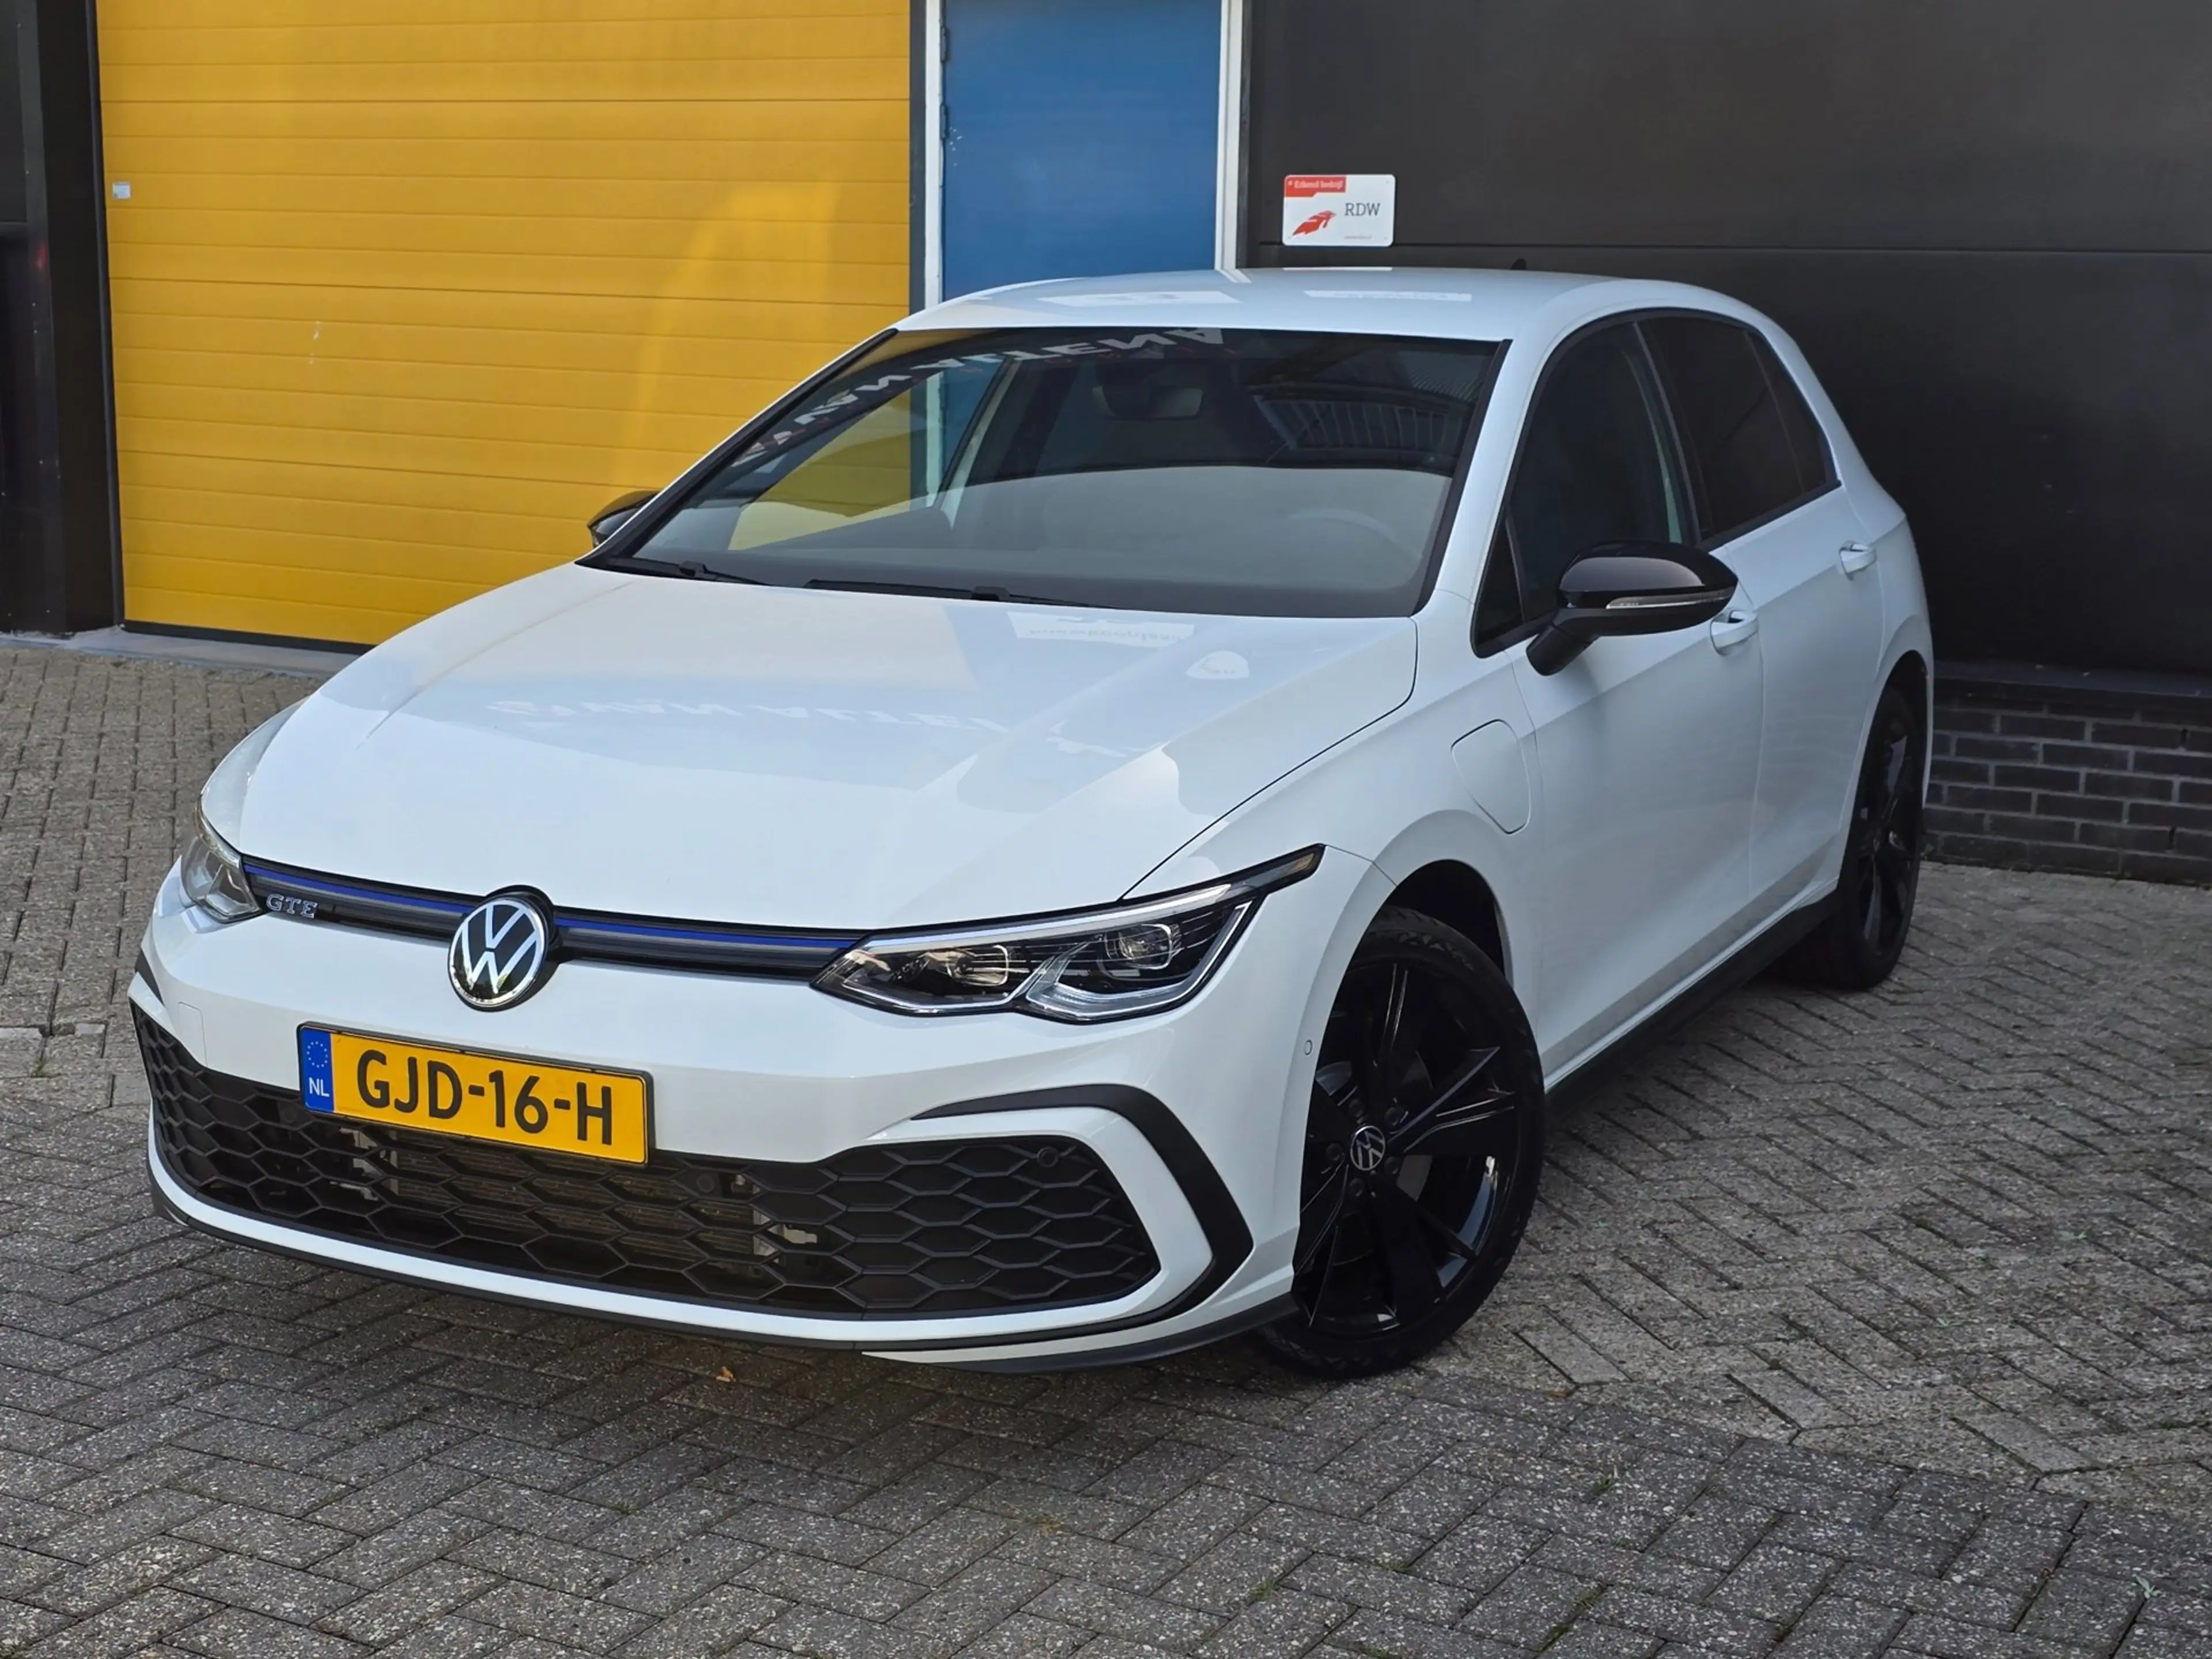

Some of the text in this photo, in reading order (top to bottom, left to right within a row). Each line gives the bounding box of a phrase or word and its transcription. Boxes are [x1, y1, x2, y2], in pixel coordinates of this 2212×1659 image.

[1344, 203, 1380, 216] RDW
[266, 893, 317, 919] GTE
[457, 902, 539, 993] VW
[308, 1050, 612, 1145] NL GJD-16-H
